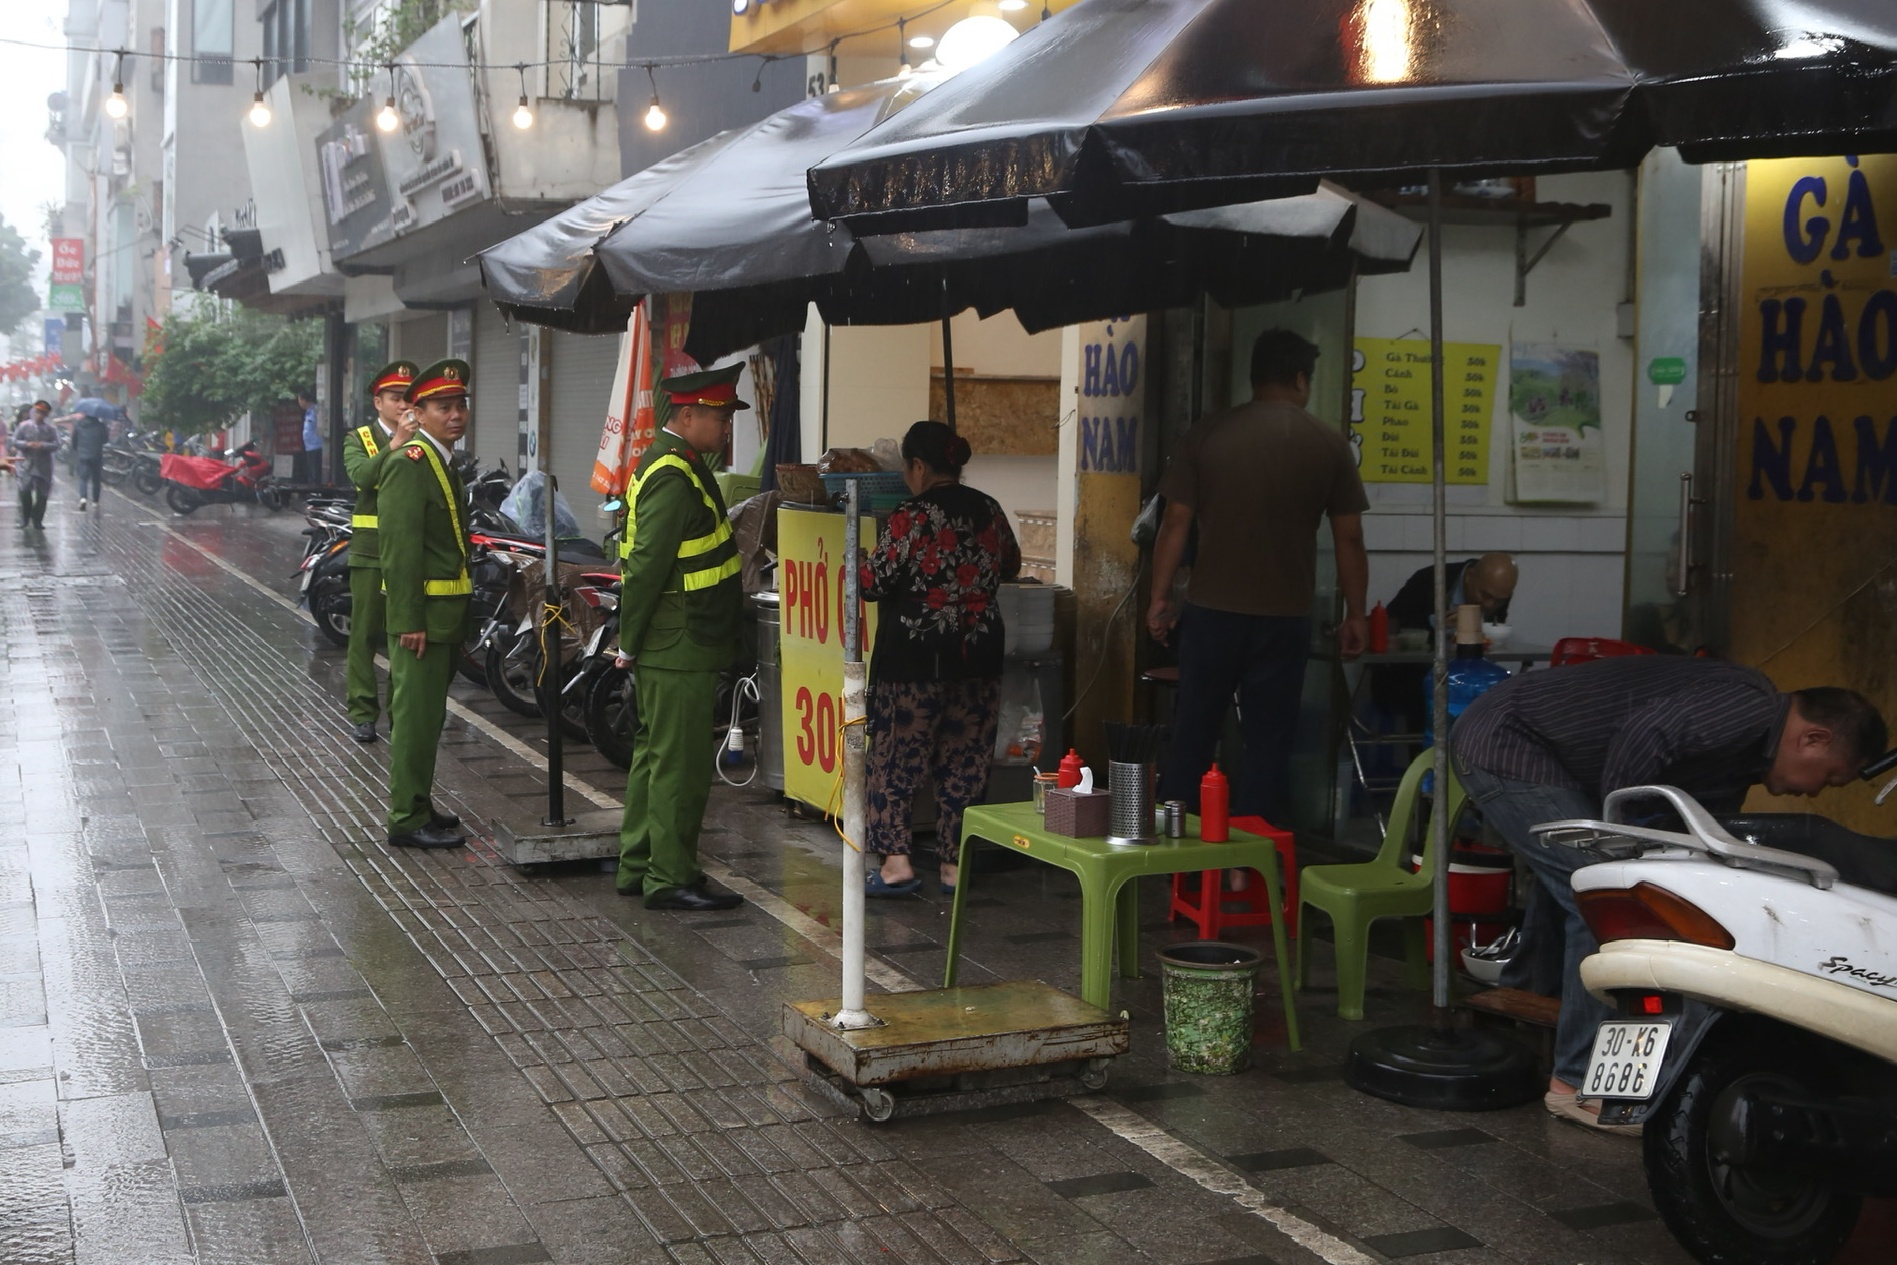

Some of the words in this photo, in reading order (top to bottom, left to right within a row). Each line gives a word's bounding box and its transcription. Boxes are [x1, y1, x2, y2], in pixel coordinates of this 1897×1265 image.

[1783, 155, 1884, 265] GÀ
[1084, 324, 1139, 397] HÀO
[1757, 269, 1897, 383] HÀO
[1081, 416, 1138, 472] NAM
[1747, 415, 1897, 505] NAM
[785, 537, 829, 645] PHỞ
[1817, 956, 1897, 987] Spacy
[1591, 1062, 1647, 1093] 8686
[1601, 1026, 1658, 1057] 30-K6
